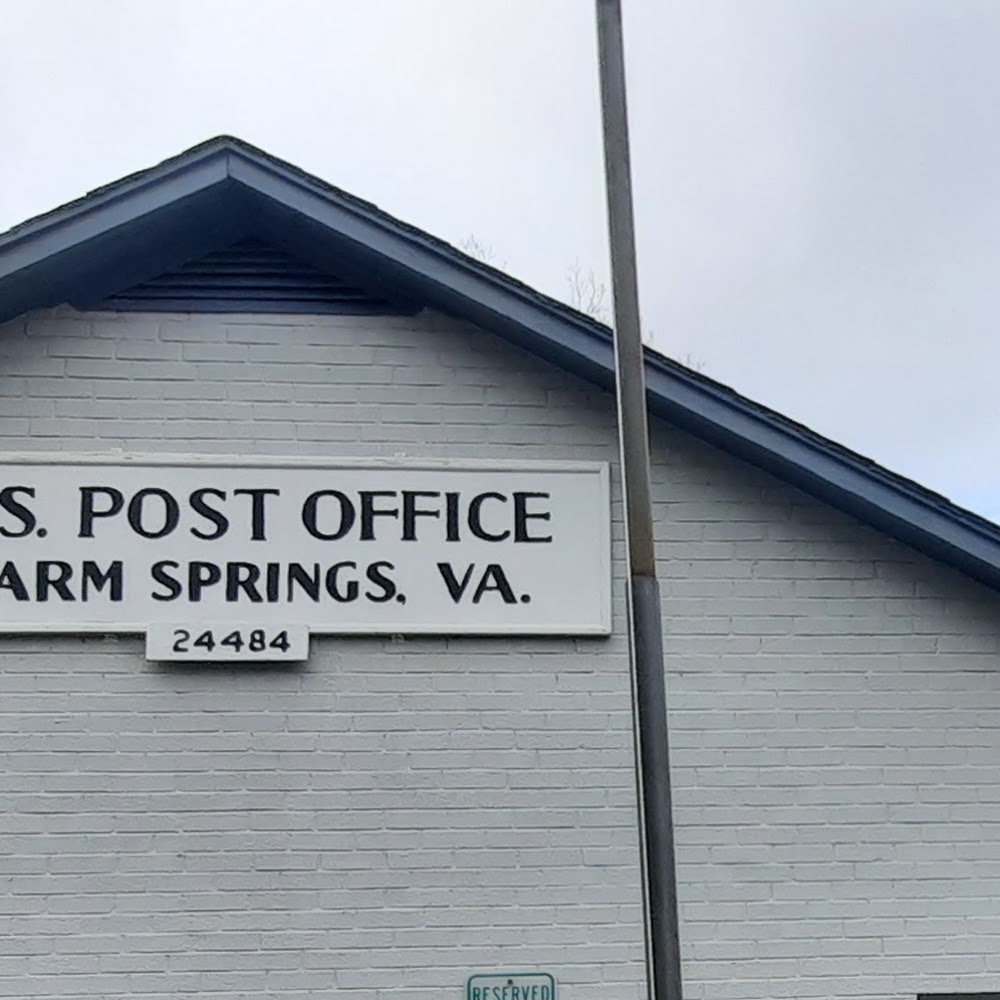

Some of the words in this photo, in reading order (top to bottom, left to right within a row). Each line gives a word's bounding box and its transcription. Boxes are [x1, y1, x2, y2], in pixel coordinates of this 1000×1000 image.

[0, 486, 48, 537] S.
[78, 486, 280, 539] POST
[301, 489, 553, 543] OFFICE
[437, 563, 531, 604] VA.
[172, 629, 291, 653] 24484
